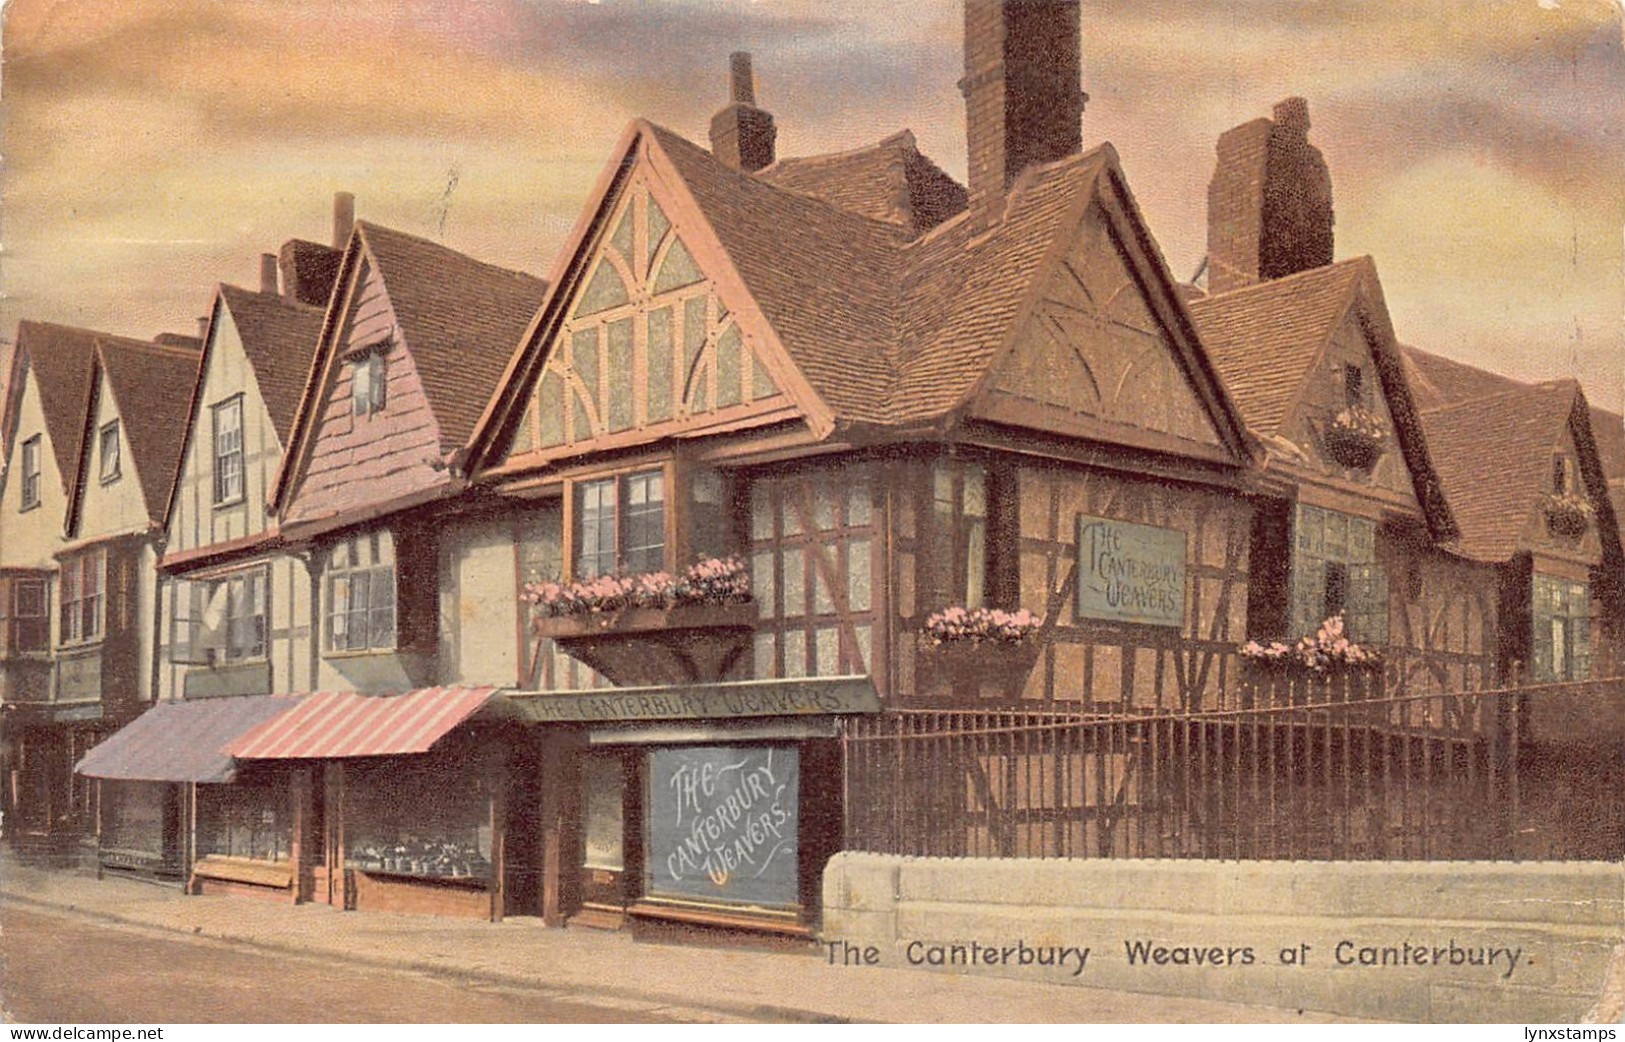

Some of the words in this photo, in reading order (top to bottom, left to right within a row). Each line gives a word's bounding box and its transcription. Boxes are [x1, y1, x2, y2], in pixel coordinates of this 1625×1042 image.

[532, 699, 566, 719] THE
[667, 748, 775, 881] CANTERBURY
[670, 762, 715, 827] THE
